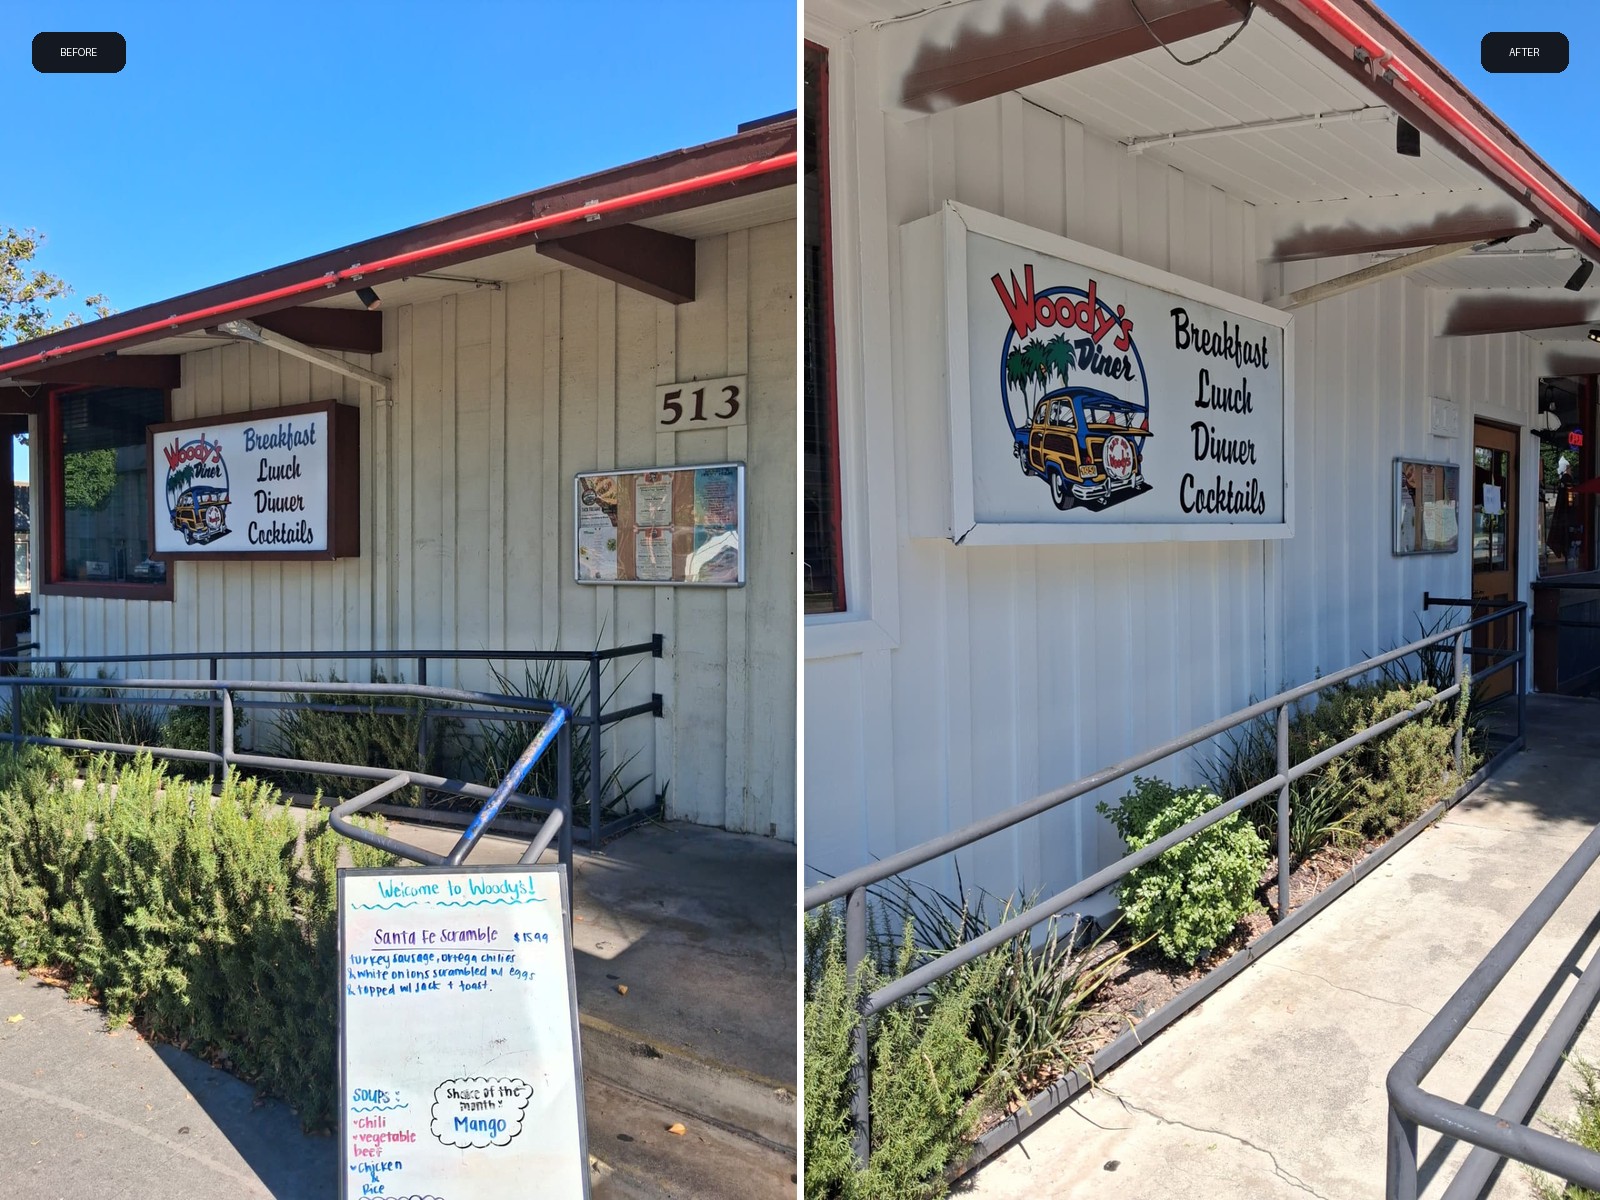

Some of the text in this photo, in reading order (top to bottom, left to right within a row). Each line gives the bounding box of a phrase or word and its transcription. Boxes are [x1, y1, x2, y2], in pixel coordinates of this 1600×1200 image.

[991, 264, 1134, 351] Woody's
[1170, 307, 1269, 369] Breakfast
[1073, 337, 1136, 382] Diner
[1194, 368, 1253, 415] Lunch
[660, 385, 740, 425] 513
[243, 422, 317, 452] Breakfast
[1191, 420, 1257, 465] Dinner
[163, 432, 223, 471] Woody's
[194, 462, 223, 479] Diner
[257, 455, 302, 482] Lunch
[254, 490, 305, 513] Dinner
[1179, 472, 1266, 515] Cocktails
[248, 520, 314, 545] Cocktails
[378, 879, 440, 899] Welcome
[448, 879, 462, 896] to
[374, 928, 417, 945] Santa
[422, 929, 437, 945] Fe
[440, 926, 499, 944] Scramble
[349, 953, 390, 969] turkey
[441, 953, 478, 966] ortega
[481, 953, 517, 963] chilies
[347, 967, 356, 980] &
[357, 969, 389, 981] white
[391, 968, 430, 980] onions
[433, 965, 488, 979] scrambled
[509, 965, 536, 981] eggs
[347, 983, 356, 996] &
[357, 983, 396, 997] topped
[446, 1085, 526, 1100] Shake of the
[358, 1115, 387, 1129] Chili
[454, 1116, 507, 1138] Mango
[359, 1129, 417, 1147] vegetable
[353, 1143, 383, 1158] beef
[358, 1160, 403, 1174] Chicken
[370, 1171, 380, 1183] &
[362, 1183, 385, 1196] Rice
